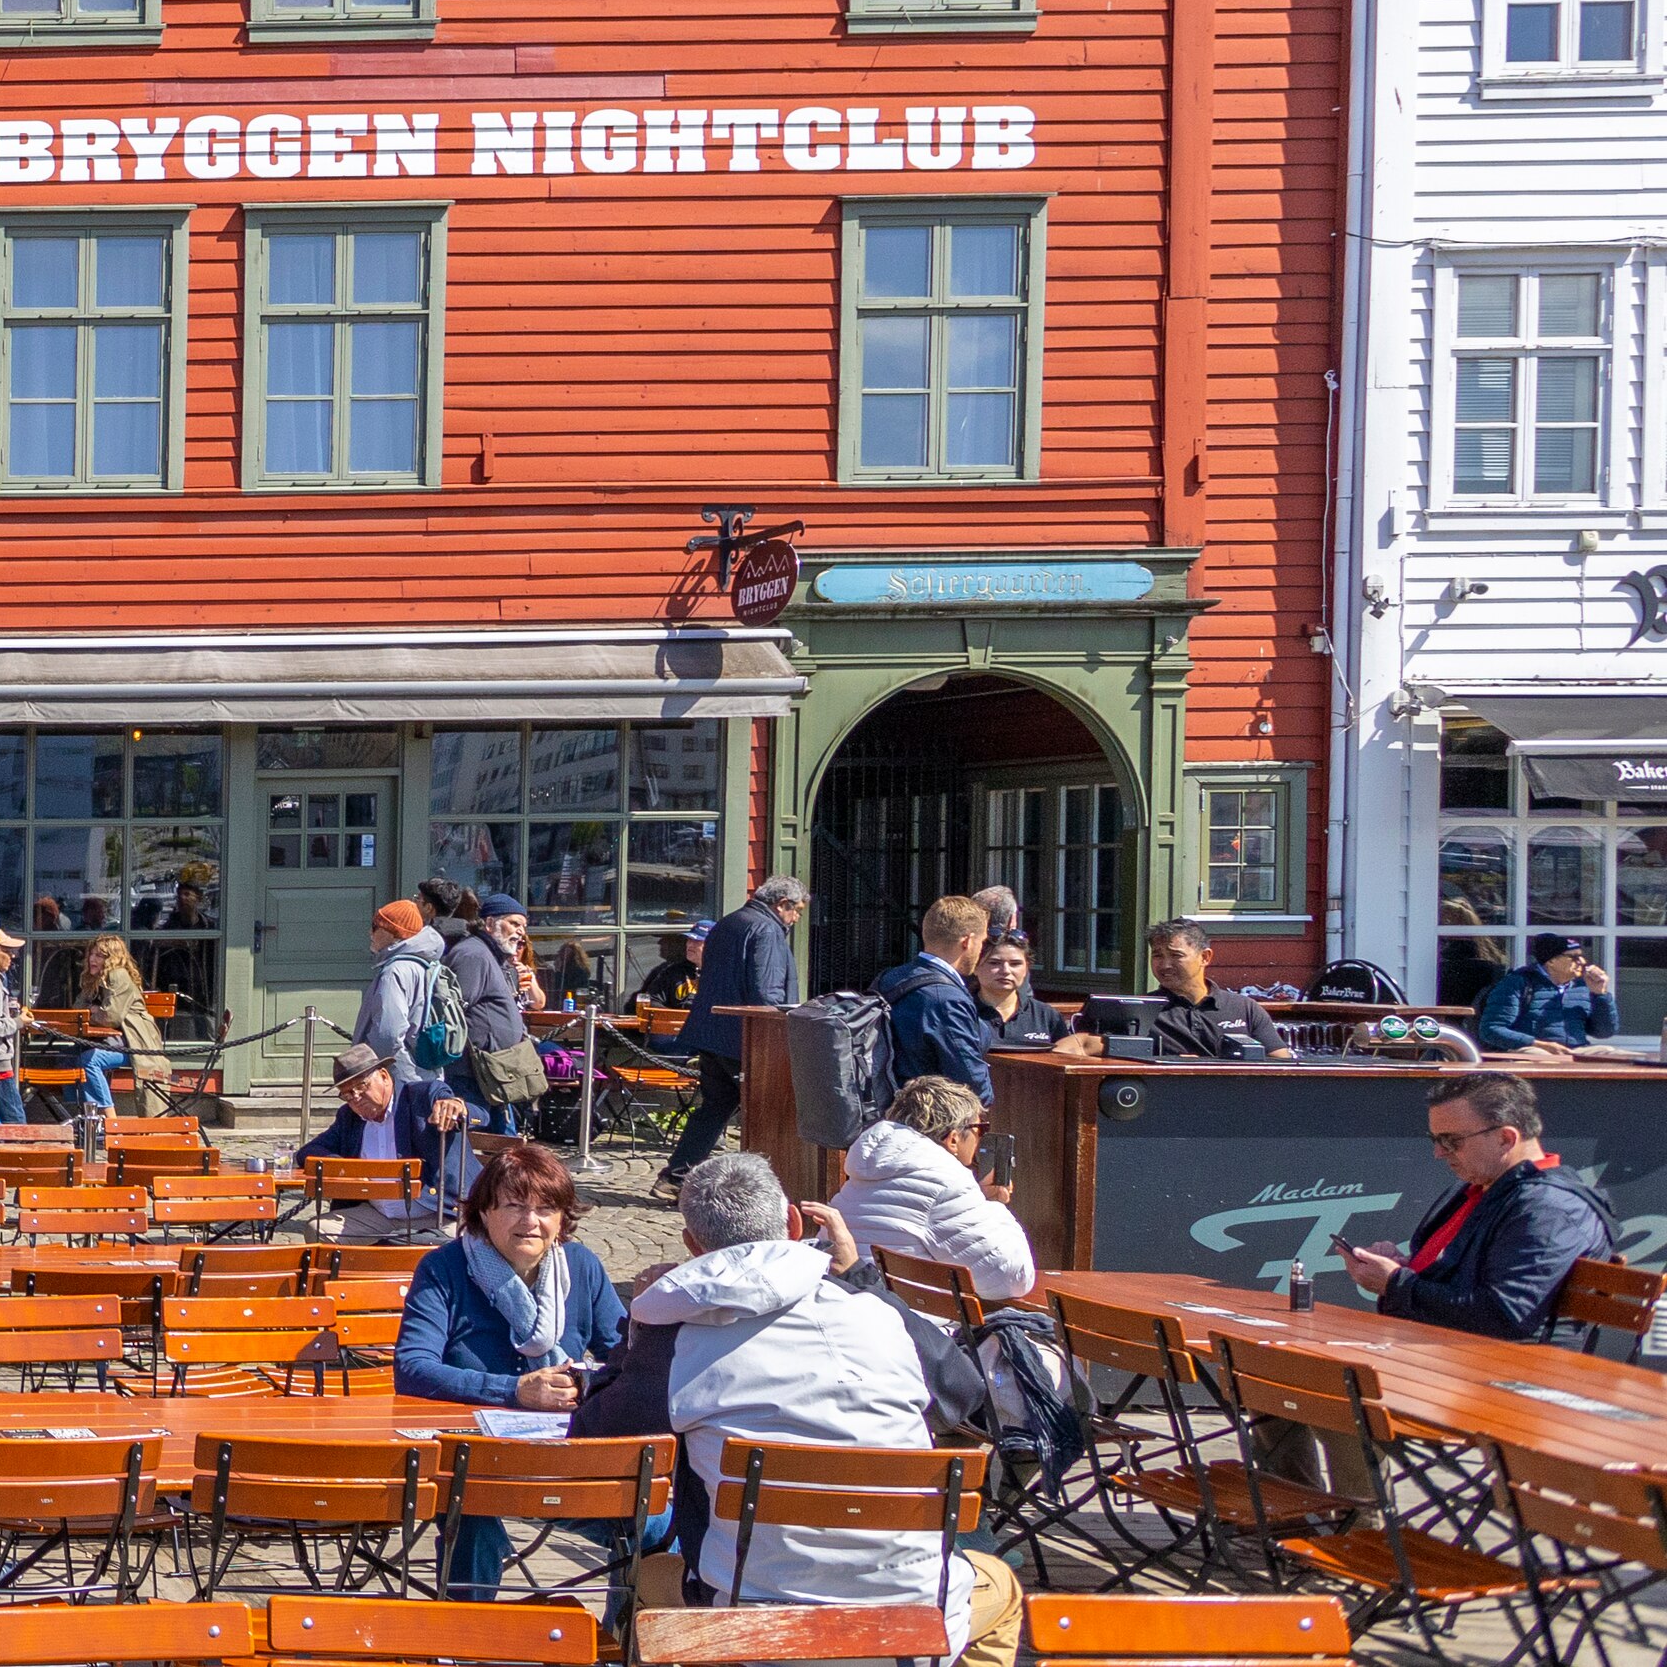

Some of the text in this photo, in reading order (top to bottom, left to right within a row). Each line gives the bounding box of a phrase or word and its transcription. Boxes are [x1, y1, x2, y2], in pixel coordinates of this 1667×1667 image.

[470, 105, 1036, 175] NIGHTCLUB
[738, 576, 790, 607] BRYGGEN
[743, 602, 778, 616] NIGHTCLUB
[1612, 760, 1667, 781] Bake
[1248, 1178, 1364, 1204] Madam
